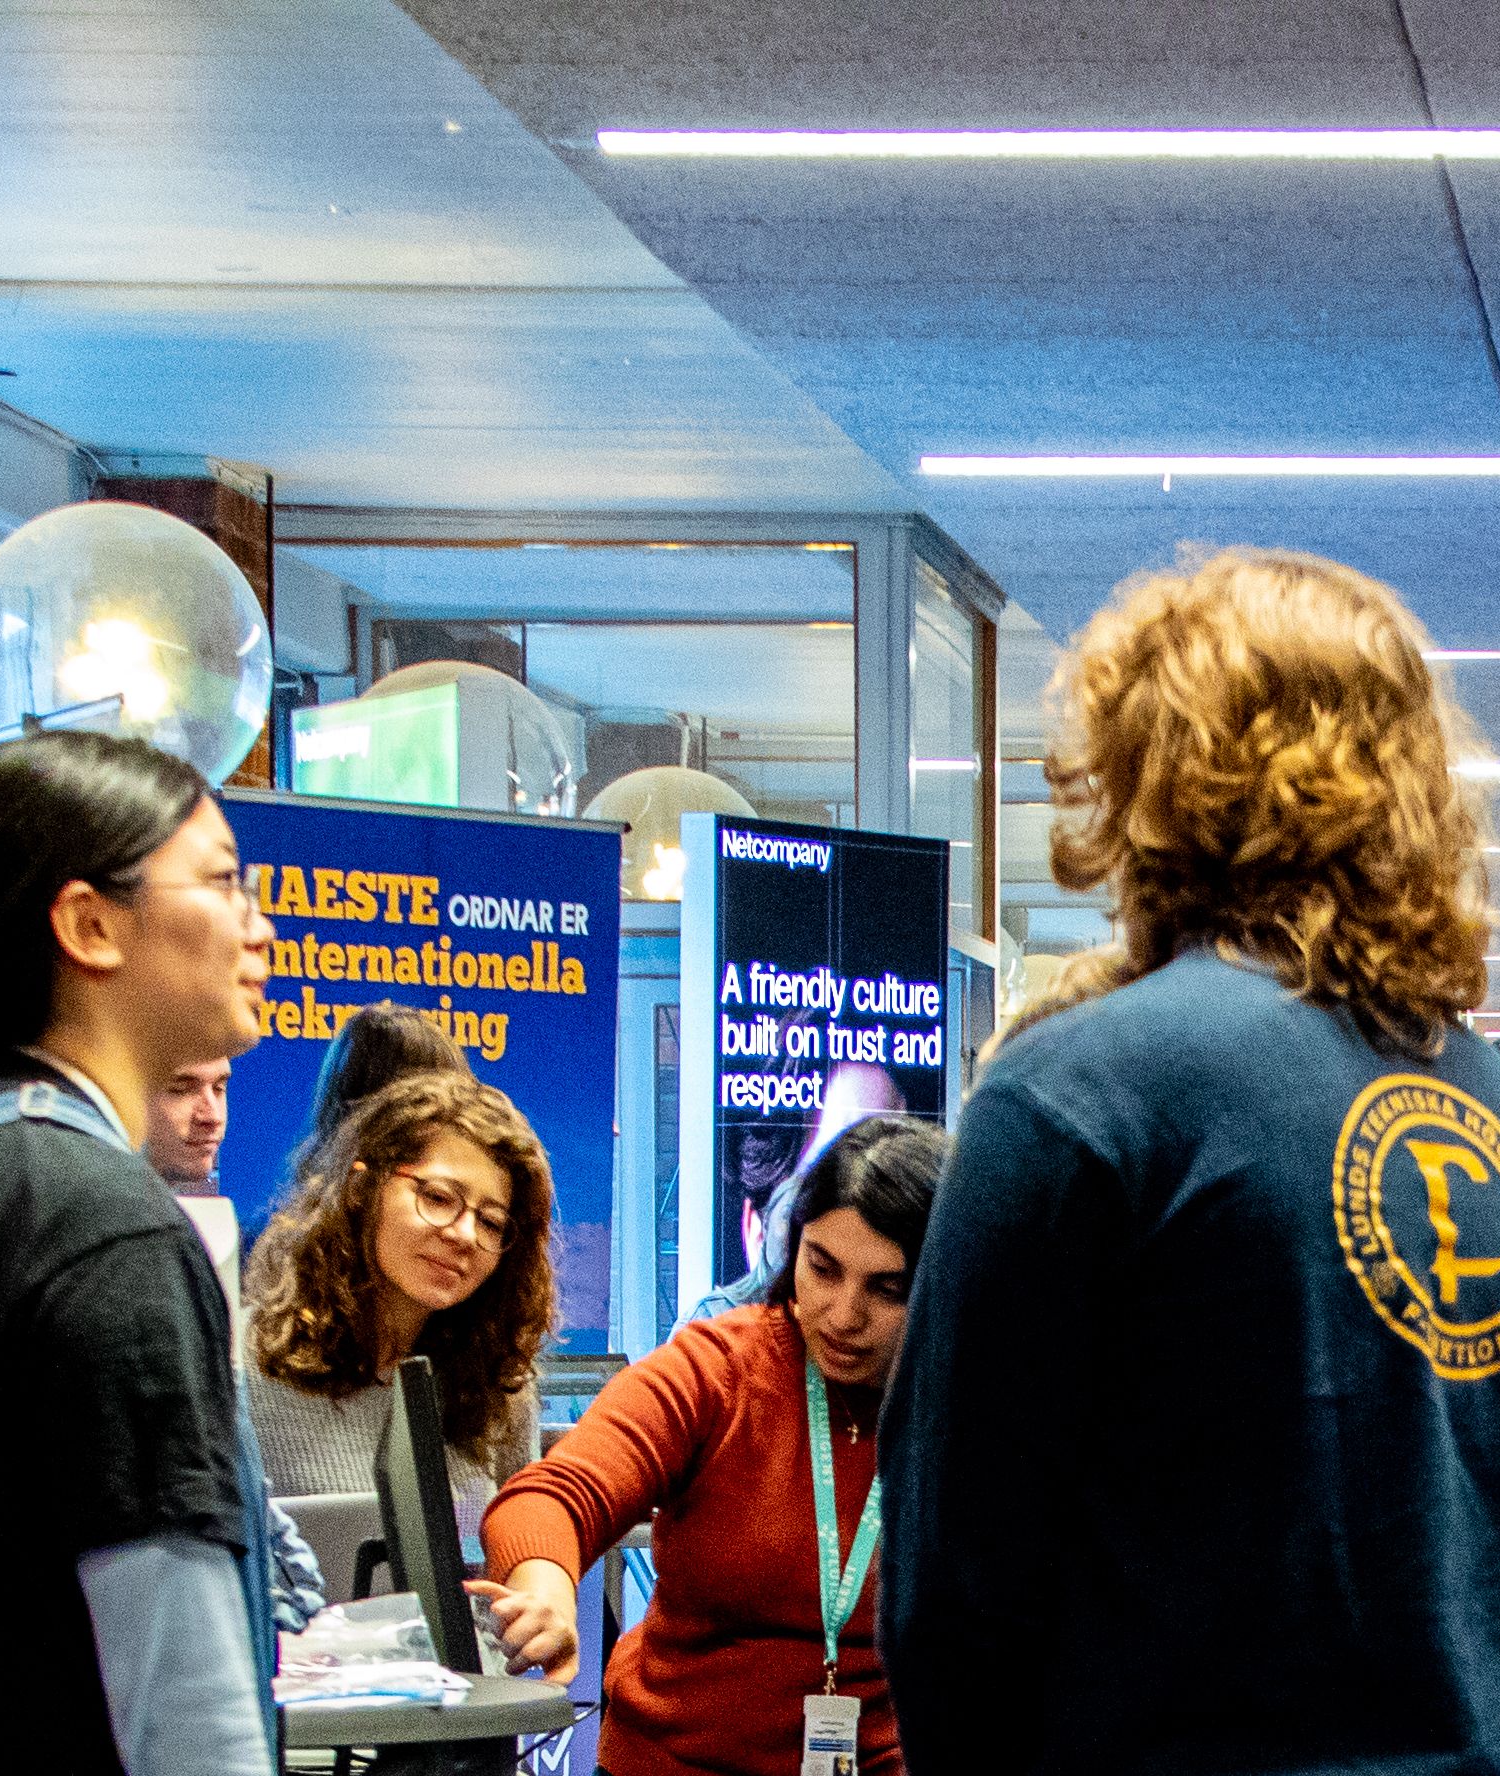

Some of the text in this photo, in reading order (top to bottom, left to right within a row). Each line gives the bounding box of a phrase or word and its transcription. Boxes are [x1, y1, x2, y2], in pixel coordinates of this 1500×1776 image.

[722, 829, 831, 871] Netcompany
[448, 894, 554, 934] ORDNAR
[561, 903, 590, 936] ER
[721, 962, 940, 1017] A friendly culture
[721, 1014, 942, 1066] built on trust and
[721, 1071, 823, 1116] respect
[1350, 1144, 1380, 1256] LUNDS
